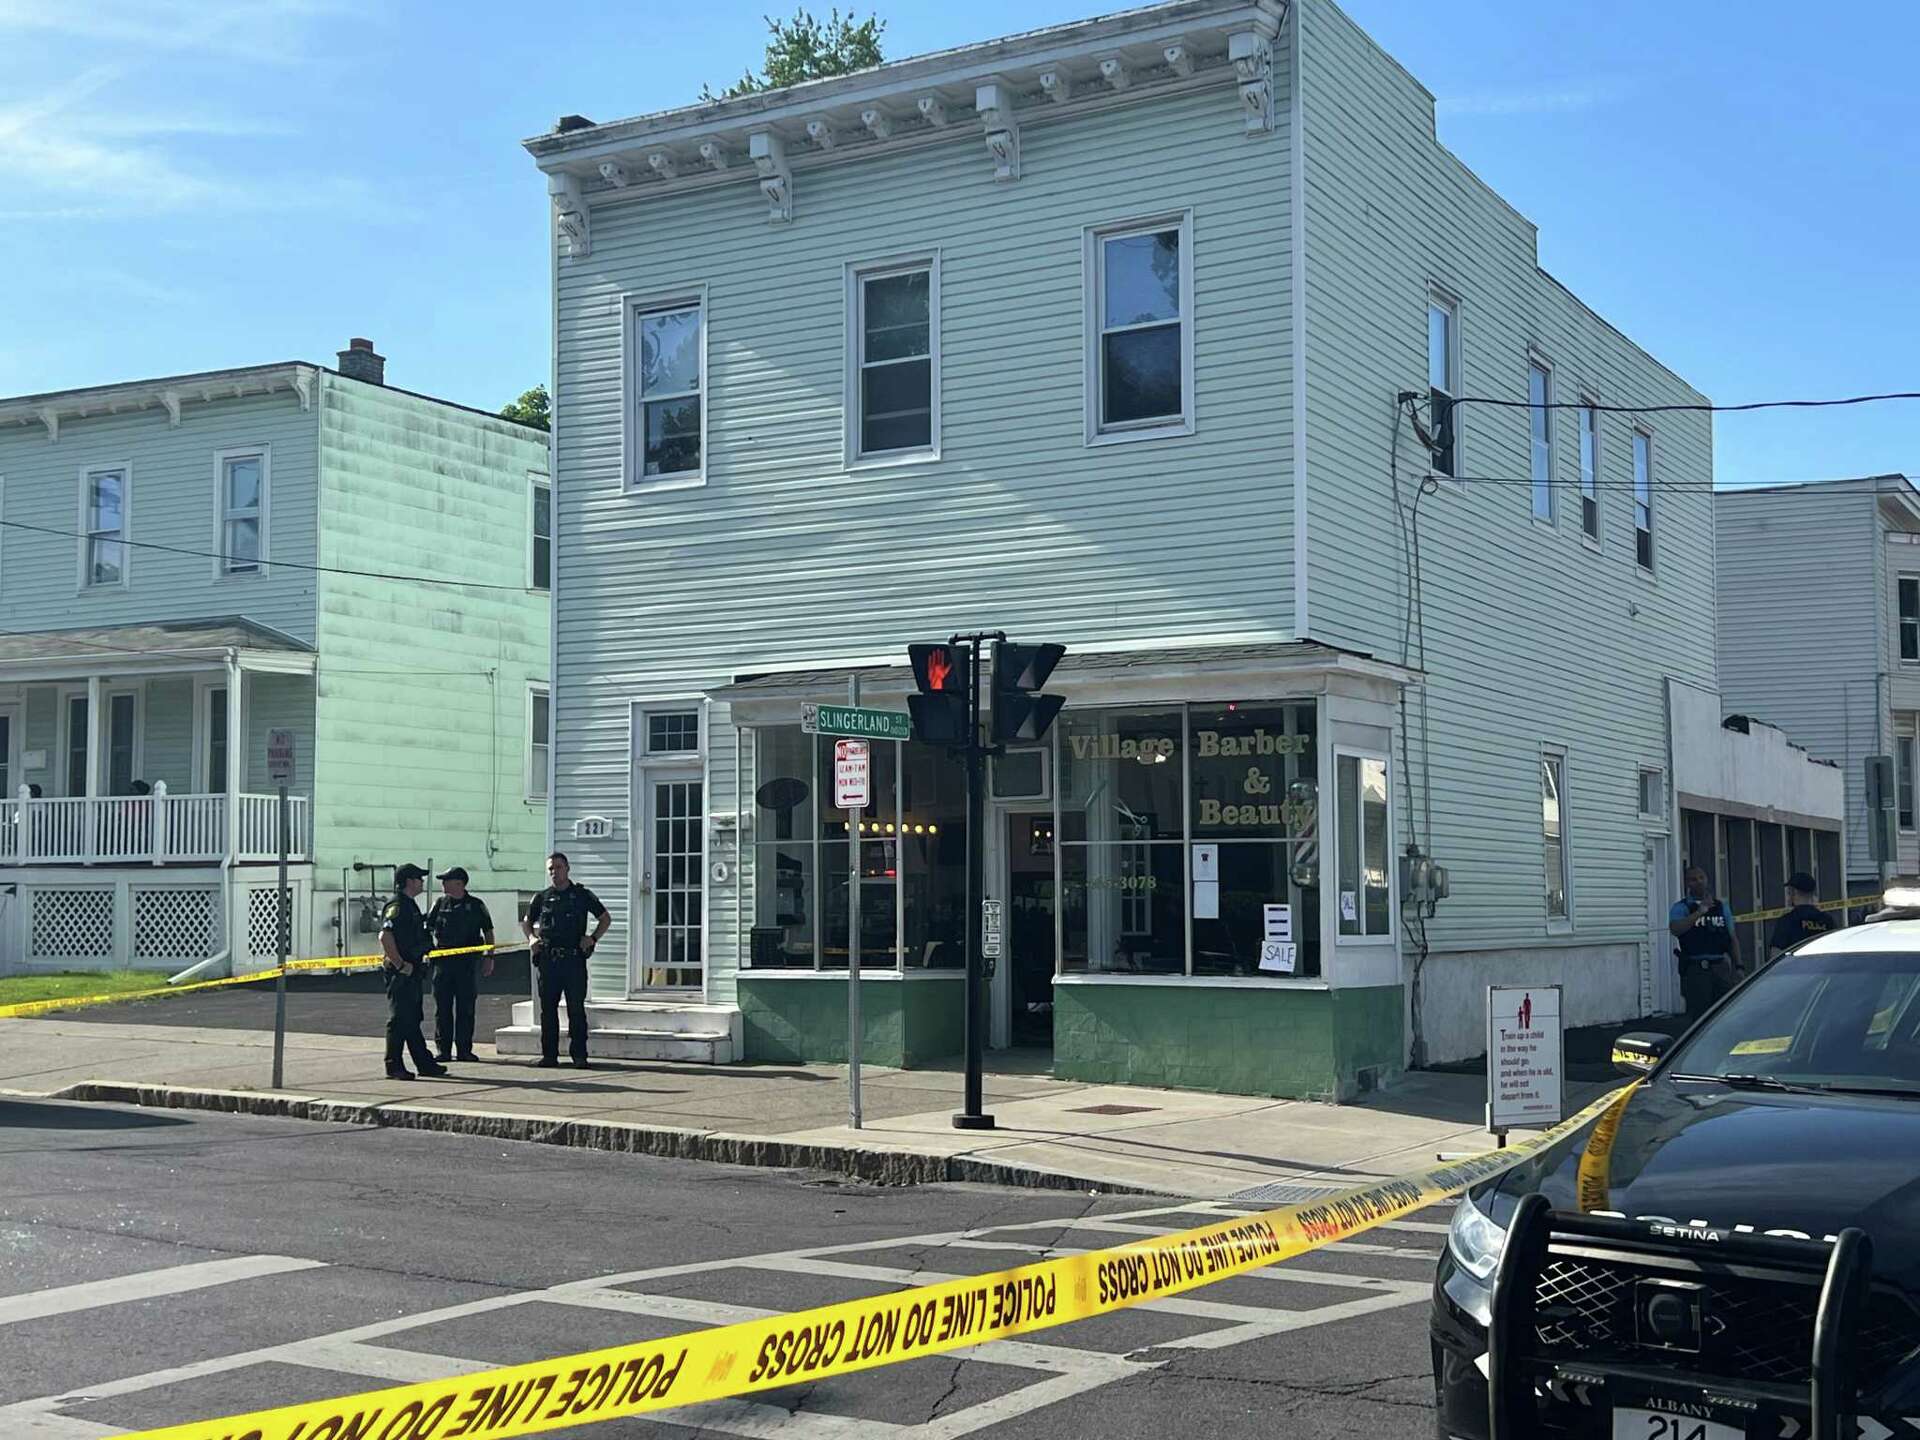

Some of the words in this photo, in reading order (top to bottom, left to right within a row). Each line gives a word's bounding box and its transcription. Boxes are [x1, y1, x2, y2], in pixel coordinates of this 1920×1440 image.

[820, 711, 890, 732] SLINGERLAND
[1068, 734, 1174, 765] Village
[1198, 729, 1310, 757] Barber
[1244, 766, 1270, 794] &
[585, 822, 603, 835] 221
[1200, 799, 1313, 832] Beauty
[1264, 945, 1295, 964] SALE
[1650, 1225, 1719, 1242] SETINA
[1098, 1253, 1149, 1304] CROSS
[1152, 1247, 1182, 1289] NOT
[937, 1288, 987, 1342] LINE
[990, 1272, 1056, 1329] POLICE
[843, 1308, 900, 1363] NOT
[902, 1299, 937, 1349] DO
[749, 1319, 845, 1383] CROSS
[442, 1374, 558, 1438] LINE
[545, 1349, 688, 1419] POLICE
[378, 1393, 457, 1440] DO
[1645, 1397, 1714, 1418] ALBANY
